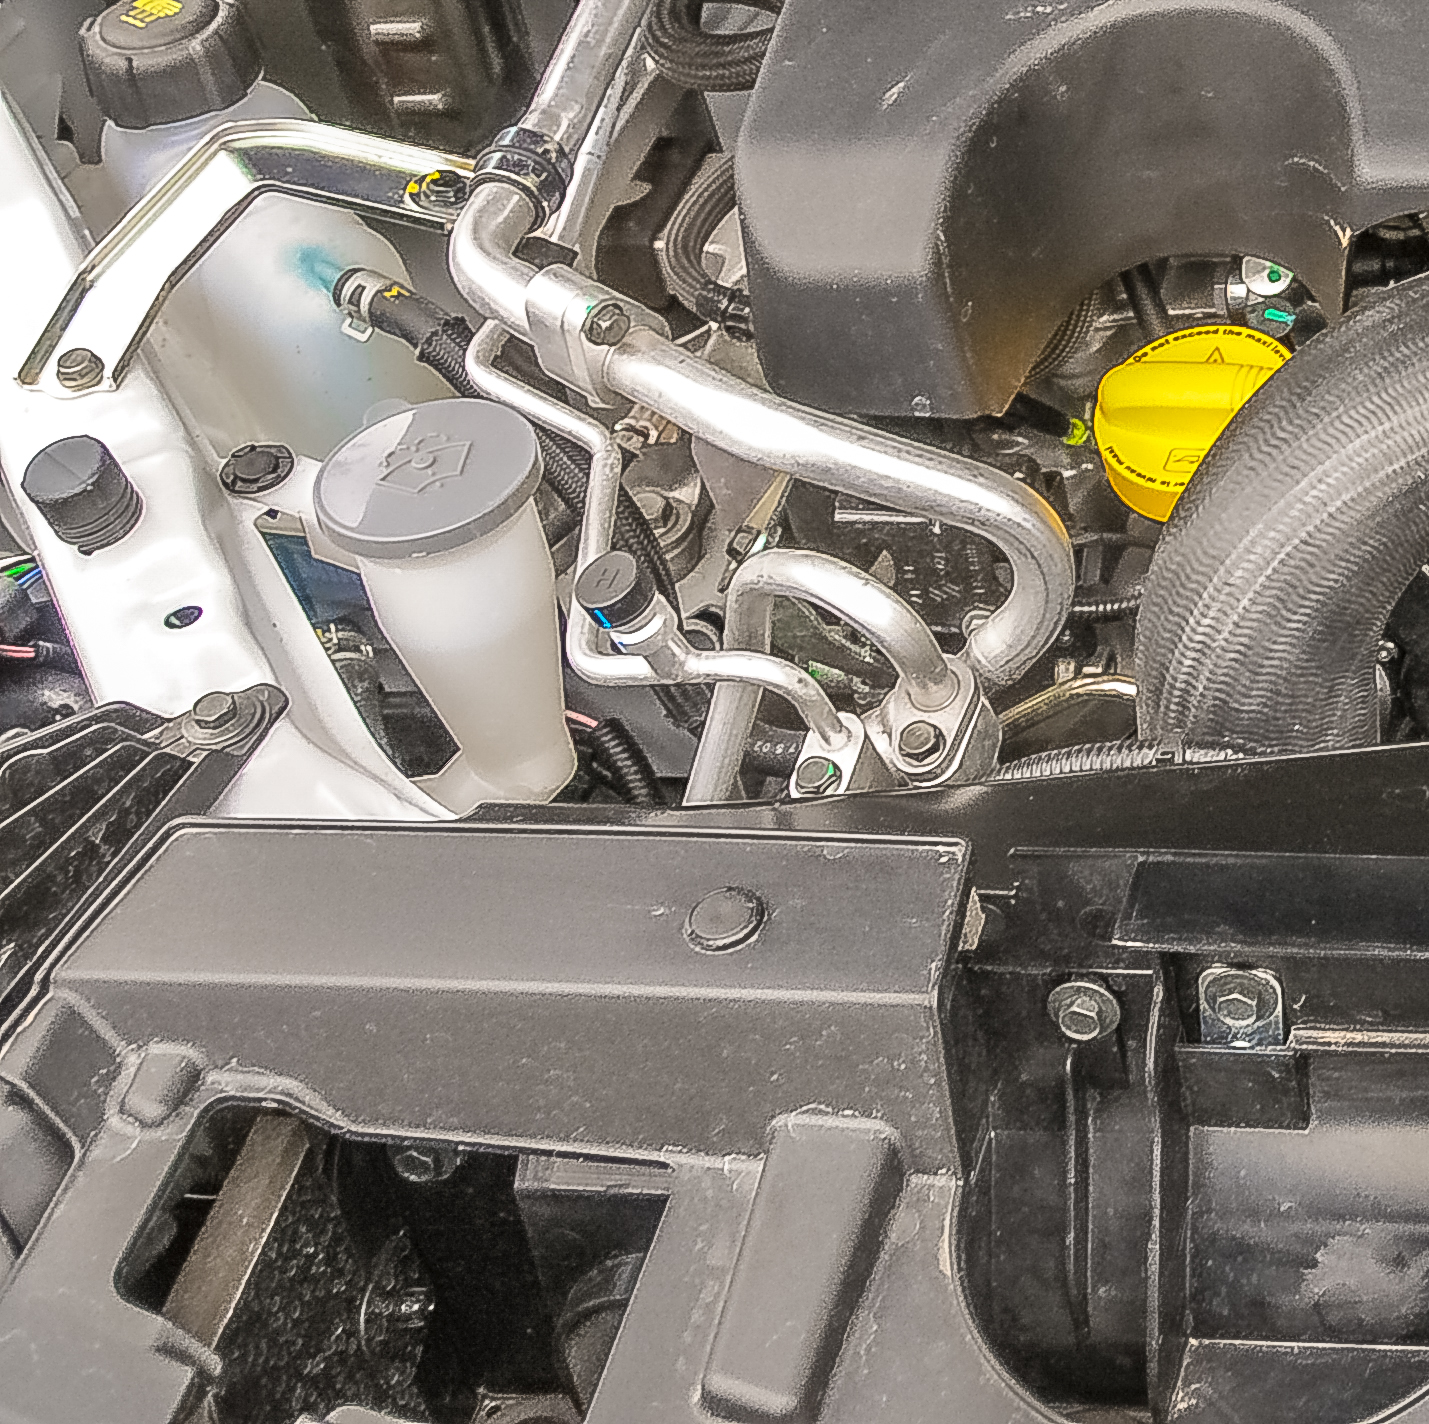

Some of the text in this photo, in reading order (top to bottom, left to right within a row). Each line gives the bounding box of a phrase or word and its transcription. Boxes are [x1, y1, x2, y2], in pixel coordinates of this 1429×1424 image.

[1132, 350, 1149, 363] Do
[1150, 338, 1171, 353] not
[1172, 327, 1220, 342] exceed
[1222, 328, 1243, 337] the
